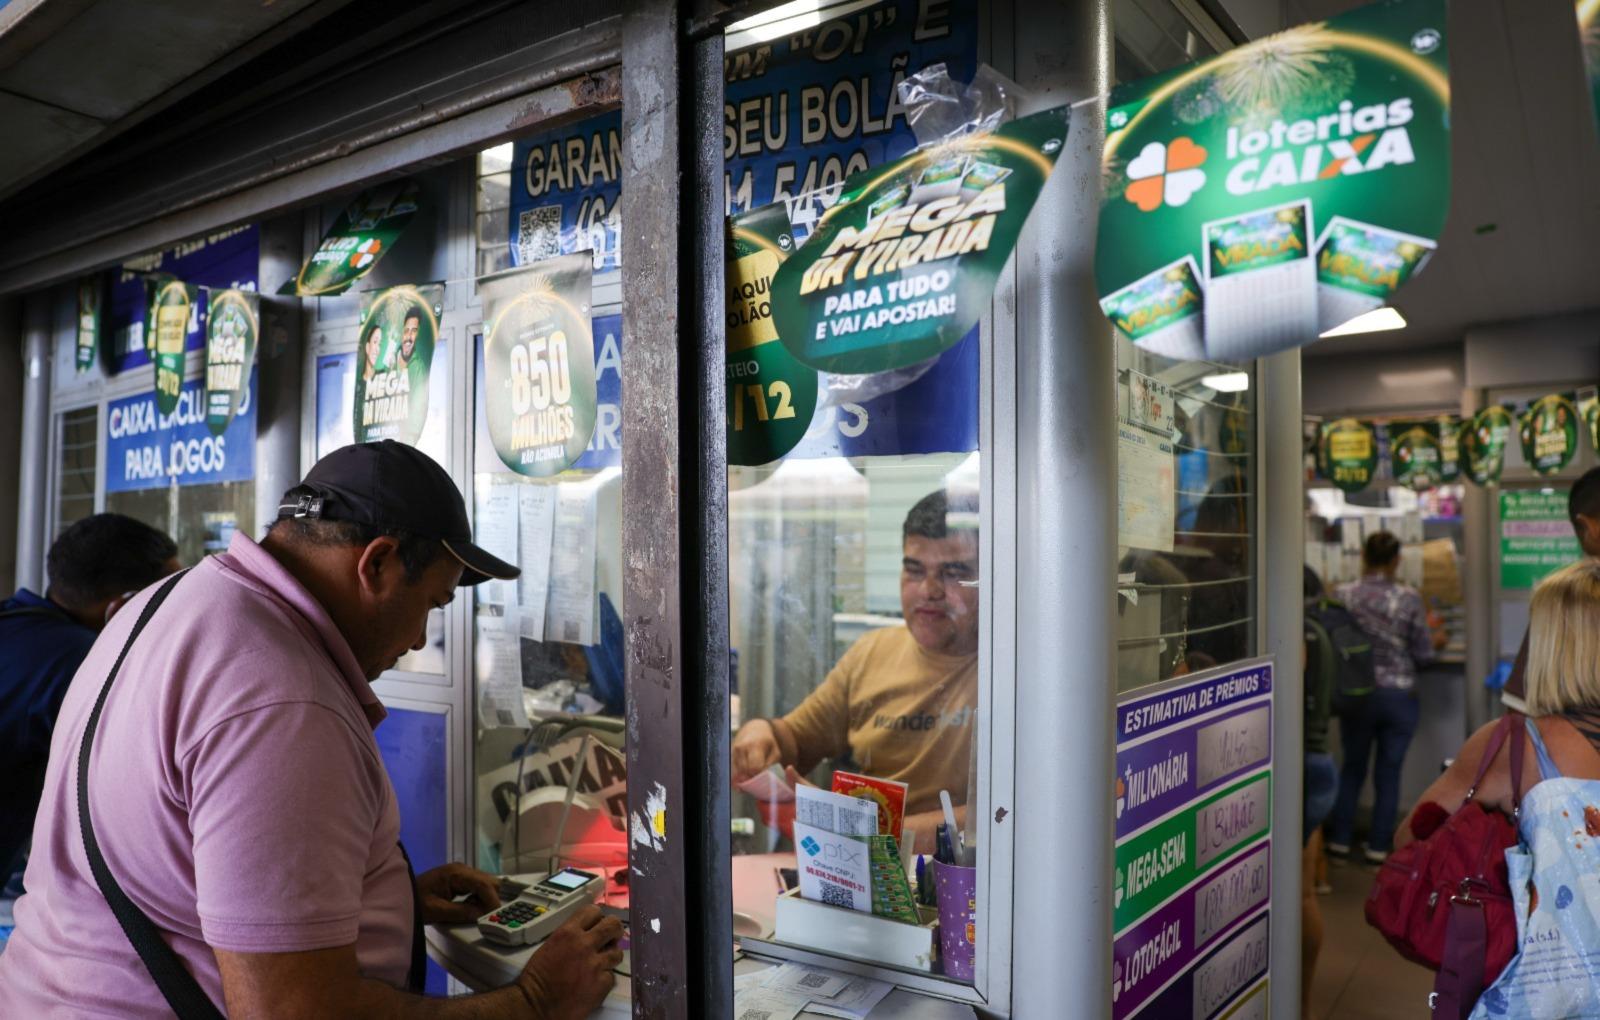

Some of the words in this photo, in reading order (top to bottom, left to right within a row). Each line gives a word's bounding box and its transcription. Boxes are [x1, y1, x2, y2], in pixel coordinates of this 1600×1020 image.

[725, 93, 788, 159] SEU
[802, 56, 911, 144] BOLÃ
[1226, 98, 1414, 159] loterias
[1225, 127, 1415, 195] CAIXA
[822, 183, 1006, 257] MEGA
[800, 250, 856, 295] DA
[853, 214, 996, 281] VIRADA
[727, 301, 773, 330] OLÃO
[815, 321, 828, 341] E
[830, 314, 860, 338] VAI
[862, 295, 957, 331] APOSTAR!
[824, 289, 883, 317] PARA
[887, 269, 950, 301] TUDO
[365, 368, 410, 400] MEGA
[510, 330, 571, 416] 850
[109, 400, 156, 439] CAIXA
[511, 404, 574, 450] MILHÕES
[727, 380, 796, 431] /12
[125, 445, 164, 481] PARA
[166, 435, 226, 477] JOGOS
[1125, 694, 1196, 734] ESTIMATIVA
[1199, 688, 1213, 708] DE
[1215, 673, 1259, 703] PRÊMIOS
[824, 842, 862, 866] pix
[1126, 831, 1186, 900] MEGA-SENA
[1124, 919, 1182, 992] LOTOFÁCIL
